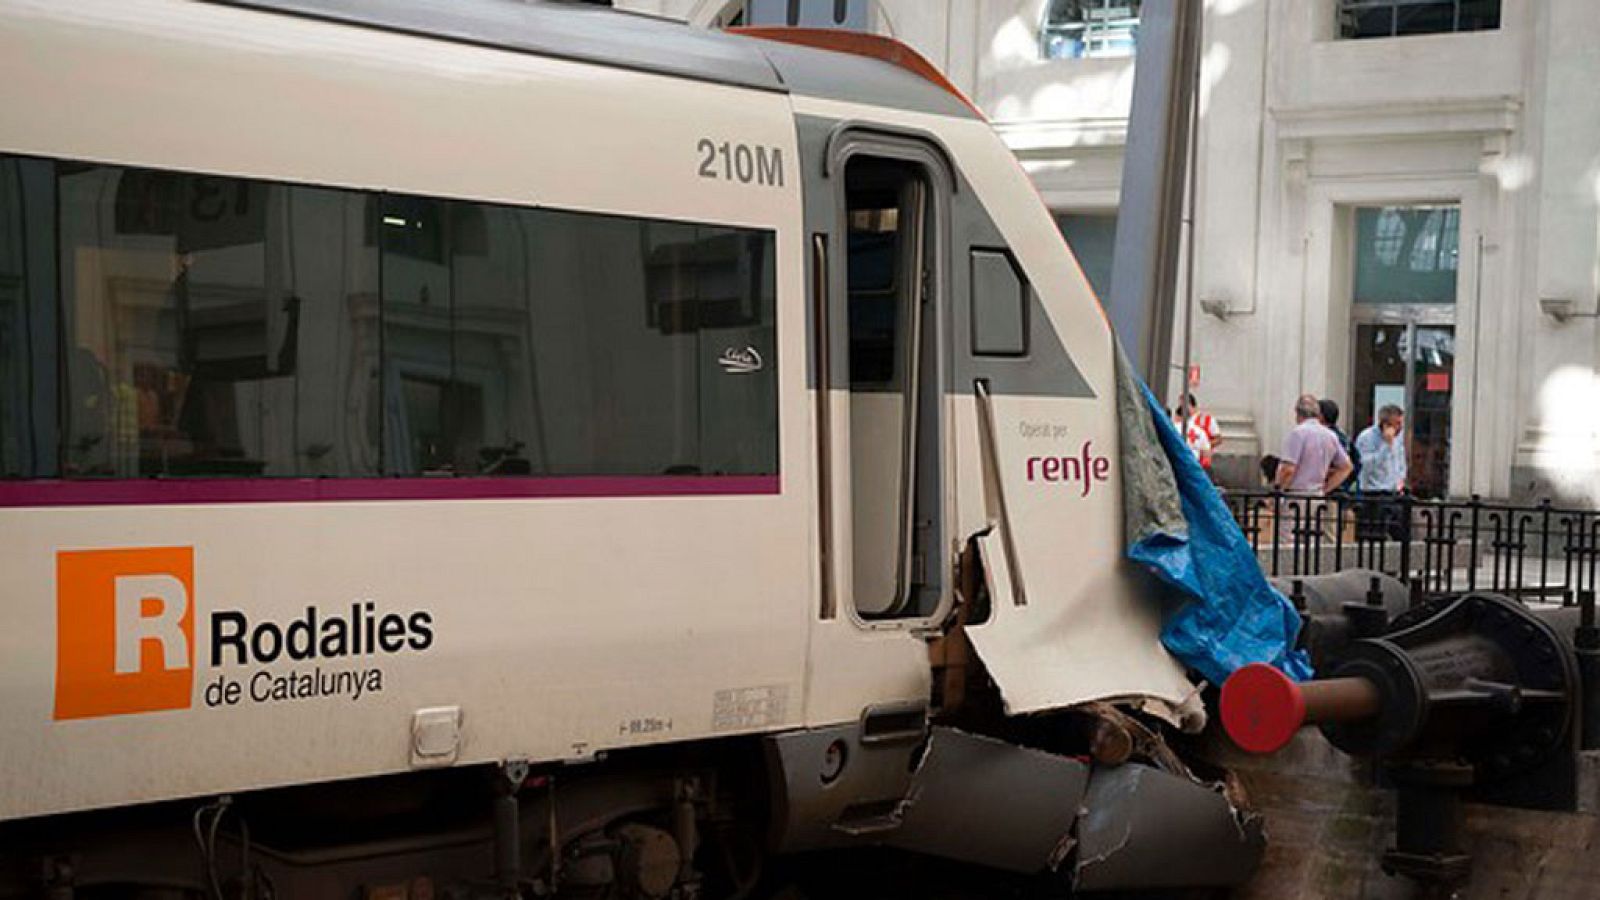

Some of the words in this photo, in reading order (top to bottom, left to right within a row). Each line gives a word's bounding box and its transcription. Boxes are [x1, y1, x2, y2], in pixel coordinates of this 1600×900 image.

[697, 138, 784, 187] 210M
[1026, 440, 1109, 498] renfe
[114, 574, 190, 674] R
[210, 602, 433, 667] Rodalies
[205, 677, 241, 706] de
[249, 667, 383, 702] Catalunya
